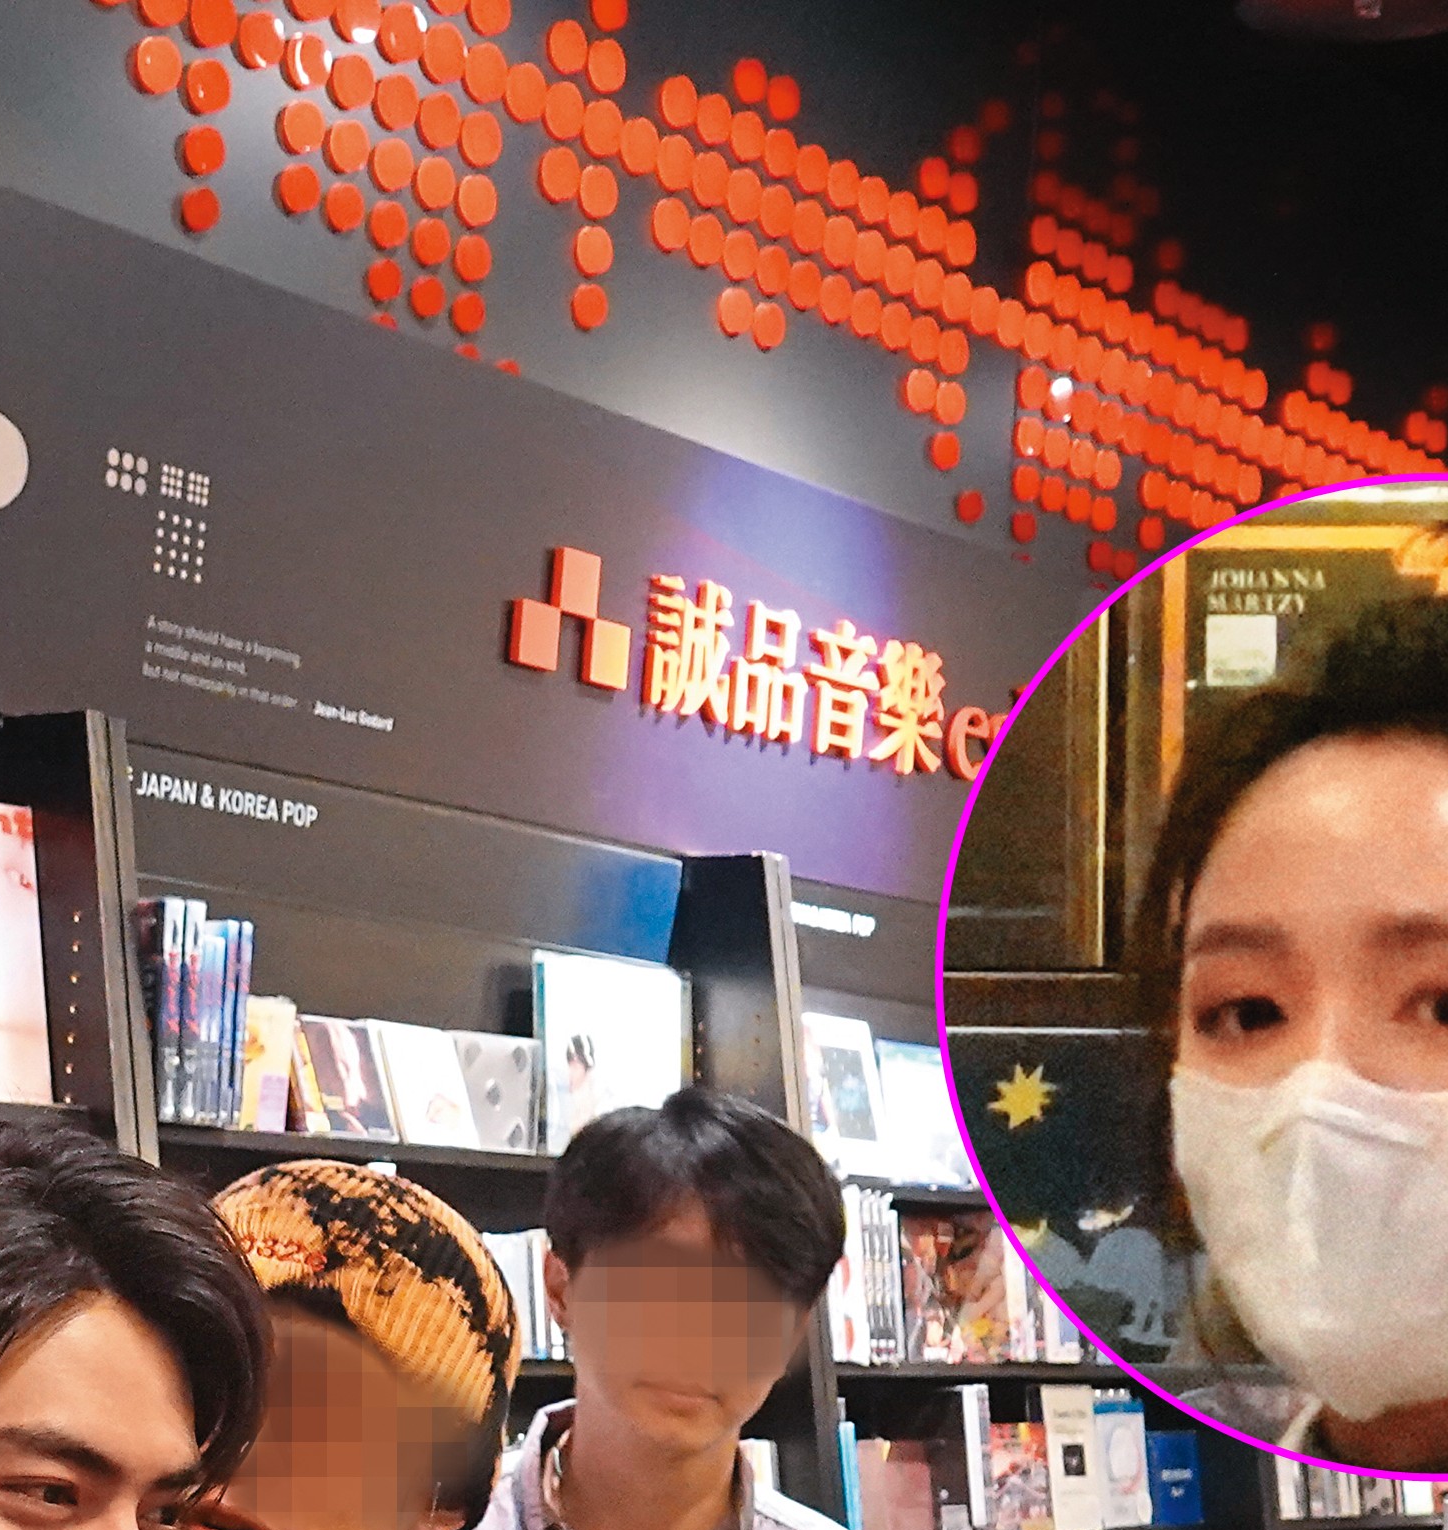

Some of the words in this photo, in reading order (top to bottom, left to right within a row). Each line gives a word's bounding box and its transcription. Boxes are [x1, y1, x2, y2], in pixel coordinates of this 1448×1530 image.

[643, 573, 946, 775] 誠品音樂
[136, 771, 197, 805] JAPAN
[200, 783, 215, 810] &
[219, 788, 279, 822] KOREA
[282, 799, 319, 828] POP
